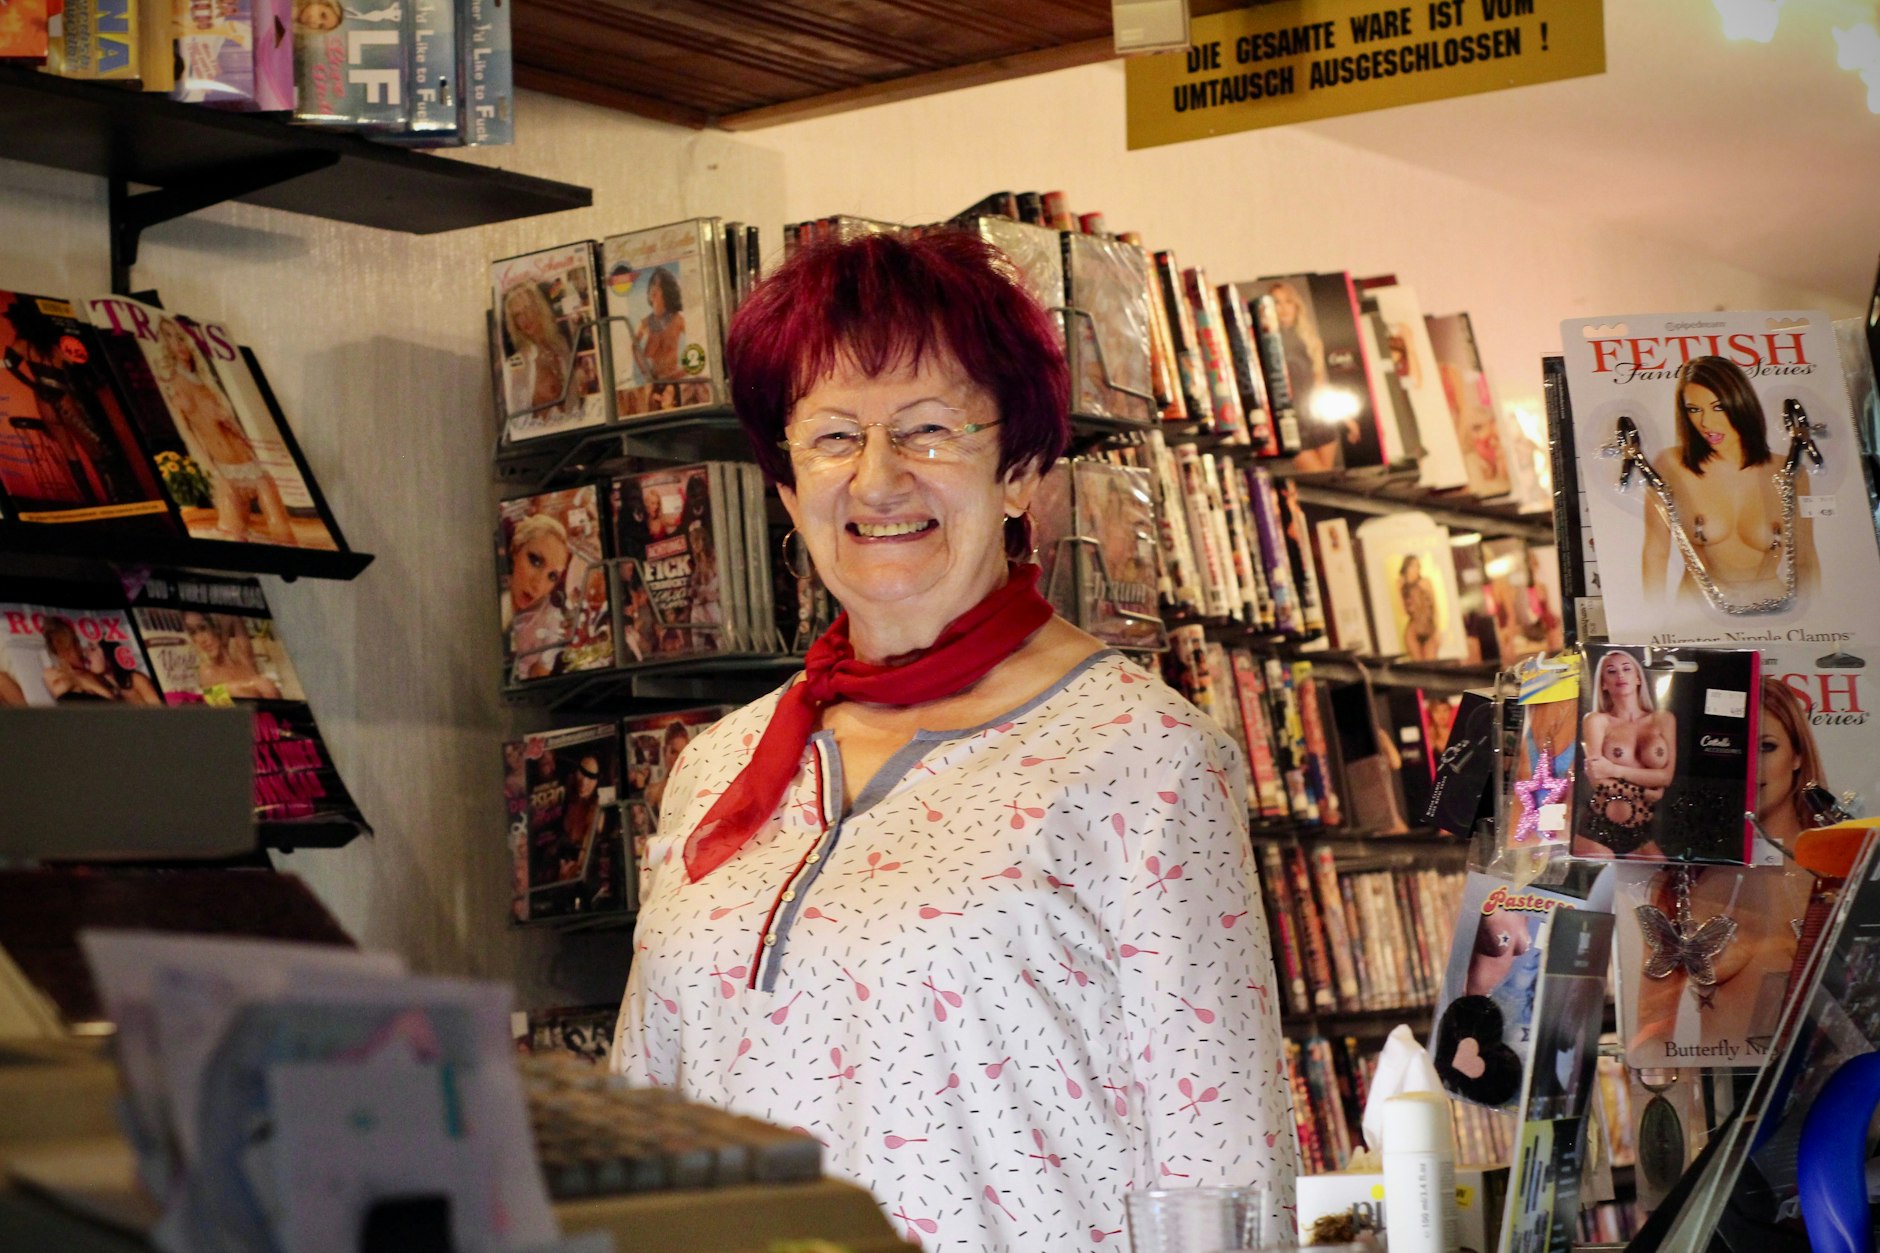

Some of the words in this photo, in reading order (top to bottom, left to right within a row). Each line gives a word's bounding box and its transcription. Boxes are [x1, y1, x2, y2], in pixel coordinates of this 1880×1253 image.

[415, 29, 434, 63] Like
[1187, 40, 1221, 75] DIE
[1236, 21, 1335, 65] GESAMTE
[1350, 8, 1412, 44] WARE
[1429, 0, 1466, 31] IST
[1482, 0, 1535, 21] VOM
[416, 67, 427, 83] to
[473, 48, 492, 81] Like
[1173, 67, 1294, 113] UMTAUSCH
[1309, 27, 1521, 90] AUSGESCHLOSSEN
[1540, 22, 1549, 51] !
[474, 85, 485, 100] to
[475, 105, 495, 142] Fuck
[90, 298, 236, 362] TRNS
[689, 349, 700, 367] 2
[1588, 333, 1812, 373] FETISH
[1613, 361, 1683, 385] Fant
[644, 553, 692, 582] FICK
[4, 611, 129, 642] ROOX
[1724, 630, 1782, 642] Nipple
[1787, 628, 1850, 643] Clamps
[114, 645, 137, 670] 6
[1481, 886, 1577, 914] Pastea
[1665, 1039, 1741, 1061] Butterfly
